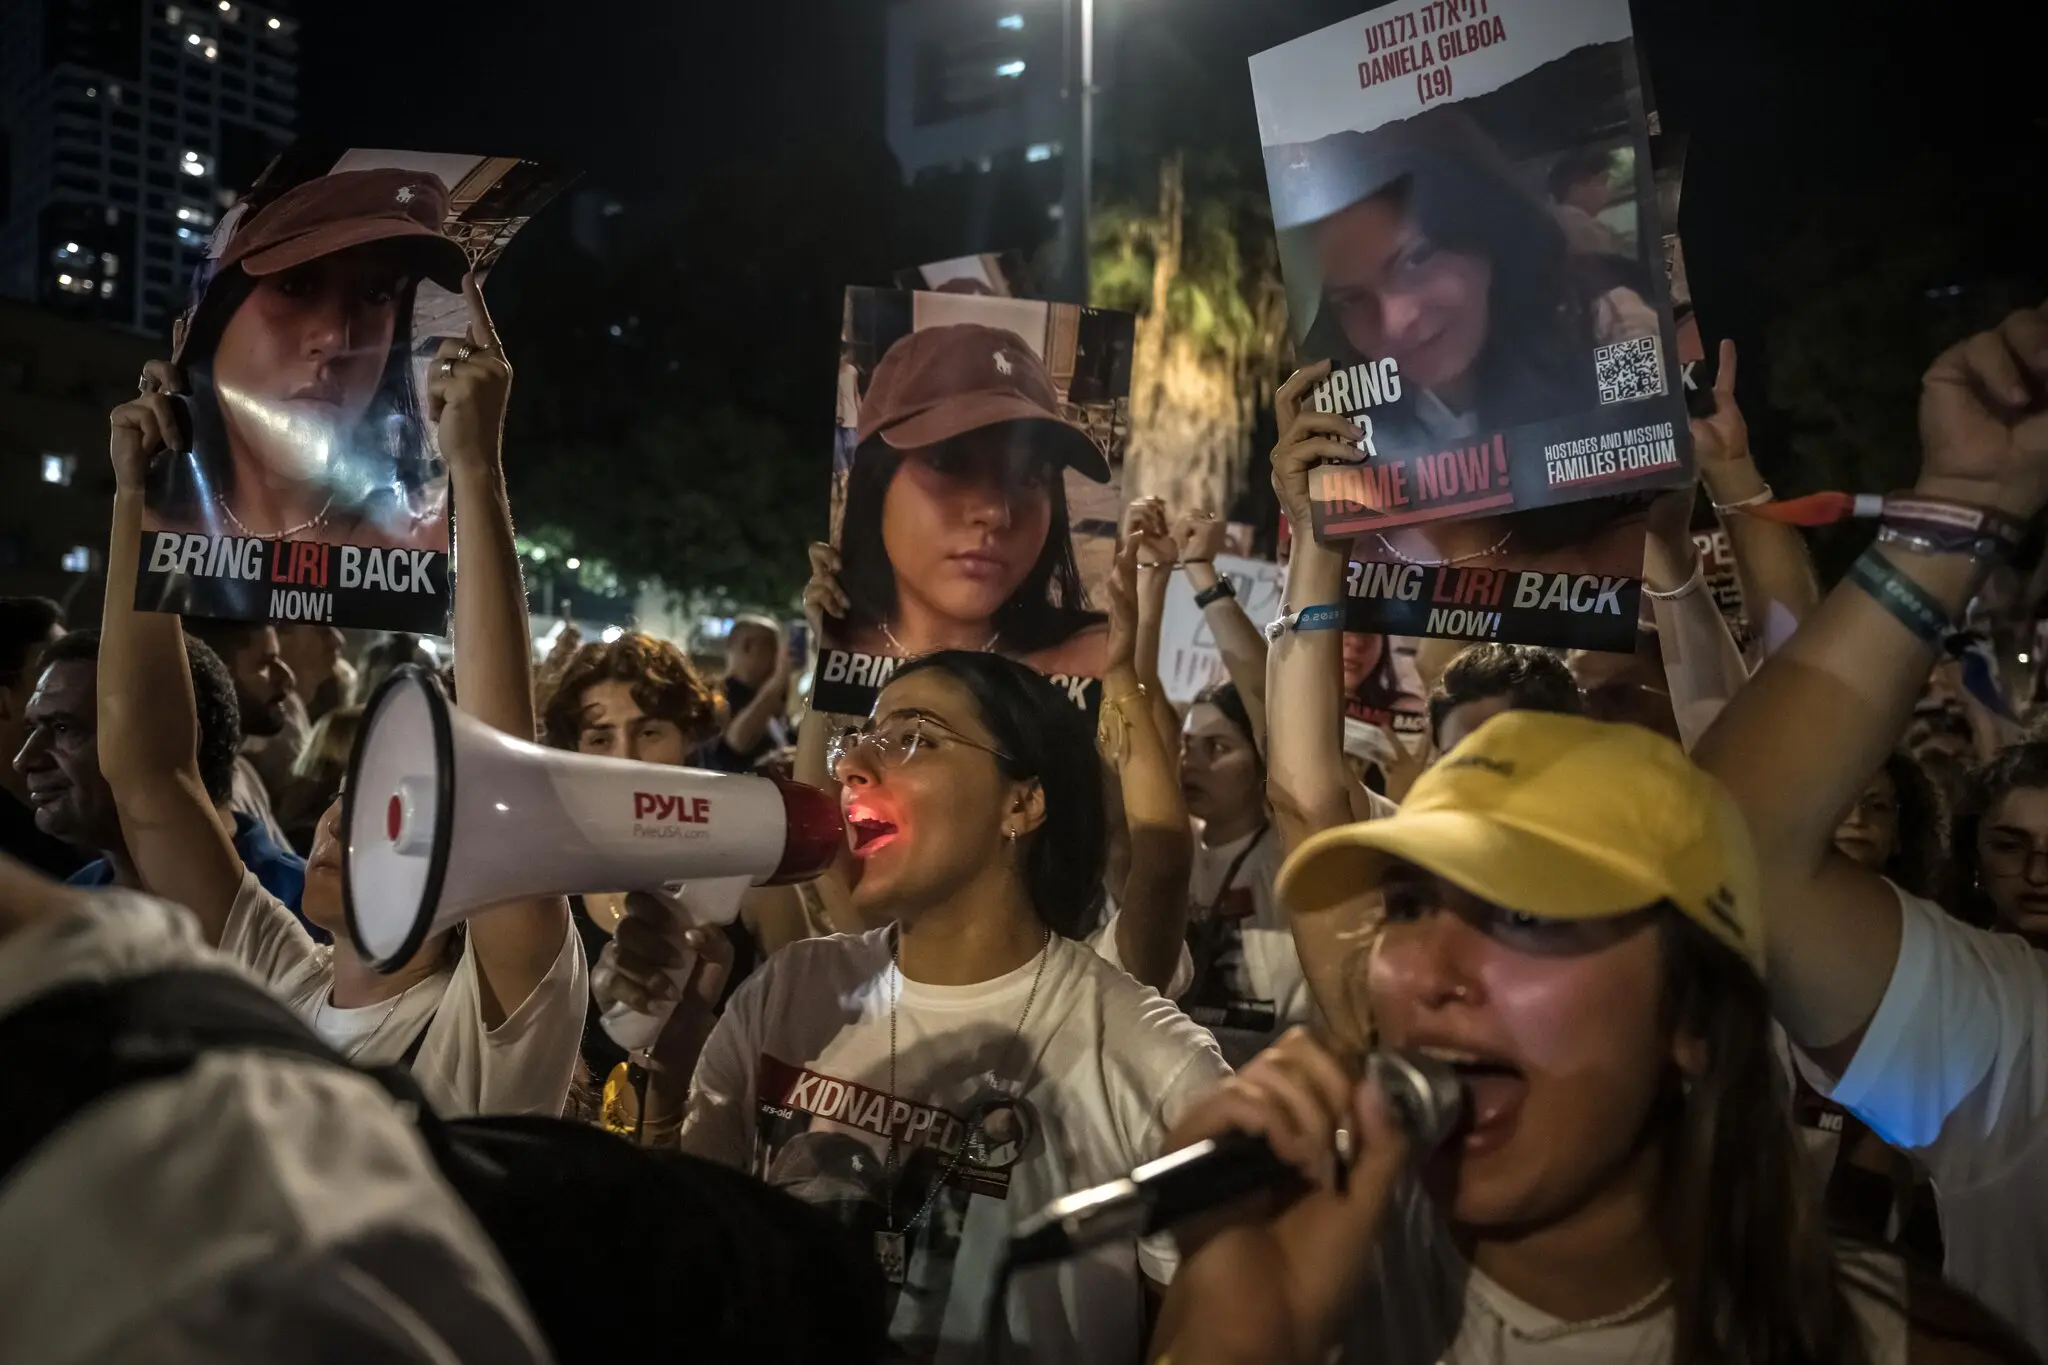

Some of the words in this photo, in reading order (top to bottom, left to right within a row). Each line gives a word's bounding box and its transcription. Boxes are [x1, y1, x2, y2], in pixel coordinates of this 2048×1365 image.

[1358, 40, 1435, 89] DANIELA
[1438, 15, 1507, 61] GILBOA
[1365, 12, 1418, 54] גלבוע
[1417, 64, 1453, 104] (19)
[1314, 357, 1401, 413] BRING
[1544, 437, 1598, 462] HOSTAGES
[1600, 432, 1622, 452] AND
[1623, 422, 1674, 445] MISSING
[1546, 452, 1616, 484] FAMILIES
[1618, 438, 1677, 472] FORUM
[1322, 461, 1409, 516] HOME
[1416, 434, 1509, 500] NOW!
[148, 532, 263, 581] BRING
[271, 539, 330, 586] LIRI
[339, 546, 436, 594] BACK
[269, 589, 333, 622] NOW!
[1346, 560, 1424, 602] RING
[1432, 566, 1504, 606] LIRI
[1514, 572, 1630, 615] BACK
[1426, 609, 1501, 638] NOW!
[823, 650, 906, 688] BRIN
[634, 792, 711, 824] PYLE
[787, 1071, 964, 1152] KIDNAPPED
